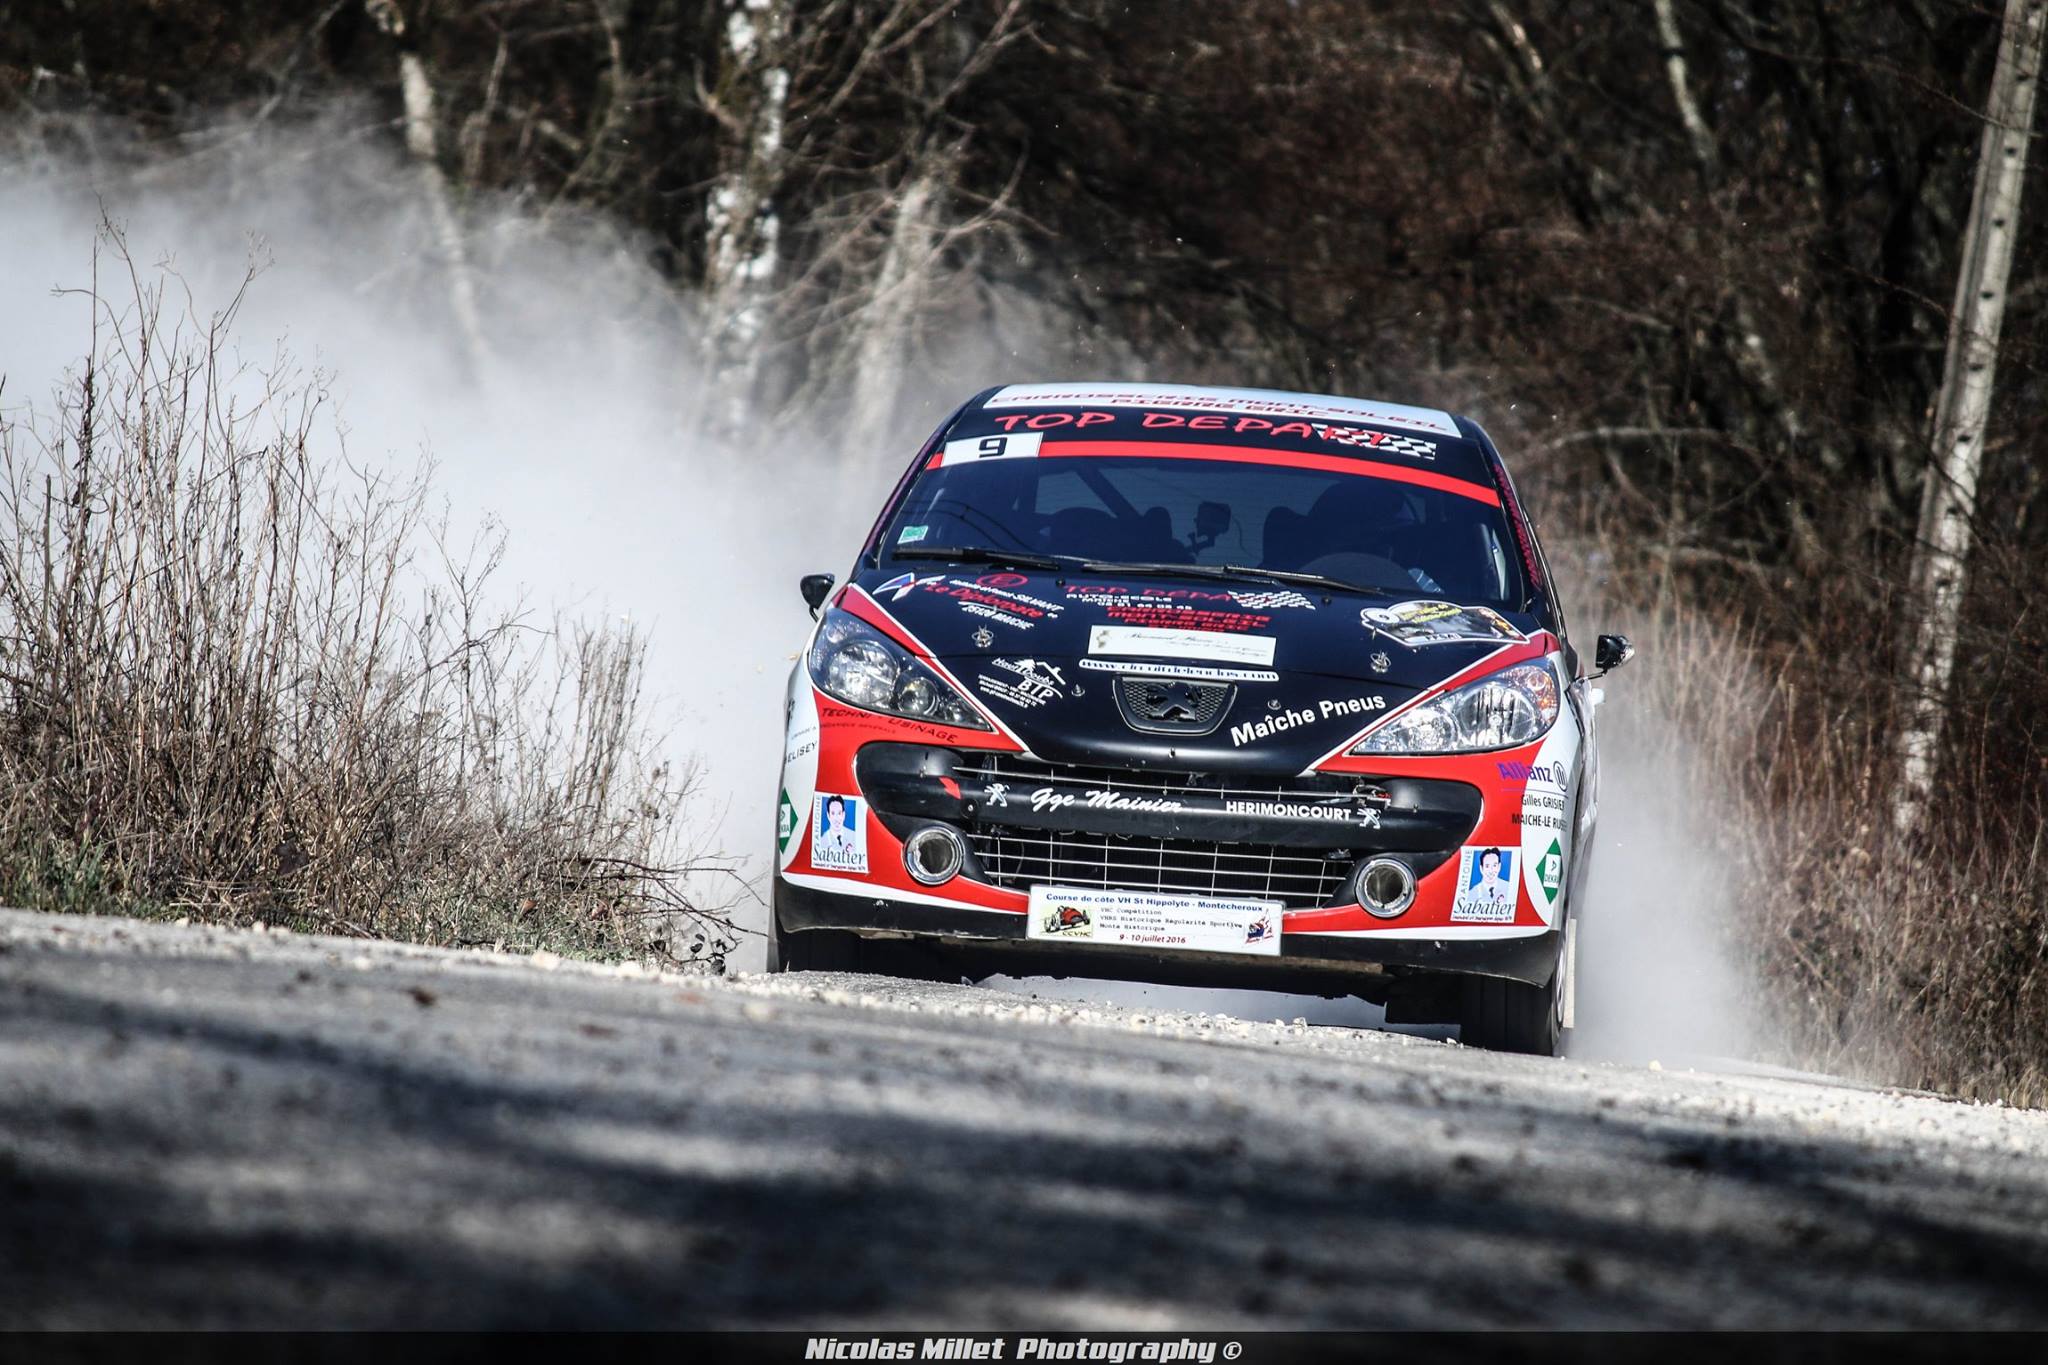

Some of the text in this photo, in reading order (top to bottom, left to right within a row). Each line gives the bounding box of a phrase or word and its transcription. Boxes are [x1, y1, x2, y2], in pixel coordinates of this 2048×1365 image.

[995, 411, 1115, 431] TOP
[978, 437, 1008, 458] 9
[1017, 680, 1054, 698] BTP
[821, 707, 872, 719] TECHNI
[887, 717, 958, 744] USINAGE
[1230, 695, 1387, 747] Maîche Pneus
[1497, 761, 1554, 783] Allianz
[1521, 793, 1542, 807] Gilles
[1225, 800, 1352, 821] HERIMONCOURT
[812, 843, 866, 865] Sabatier
[1460, 849, 1473, 895] ANTOINE
[1046, 893, 1079, 902] Course
[1081, 894, 1092, 903] de
[1094, 895, 1115, 904] côte
[1134, 897, 1144, 905] St
[1146, 898, 1190, 908] Hippolyte
[1453, 896, 1516, 916] Sabatier
[1120, 916, 1162, 925] Historique
[1209, 920, 1243, 930] Sportive
[1124, 924, 1165, 933] Historique
[1140, 934, 1165, 944] juillet
[1165, 936, 1187, 944] 2016
